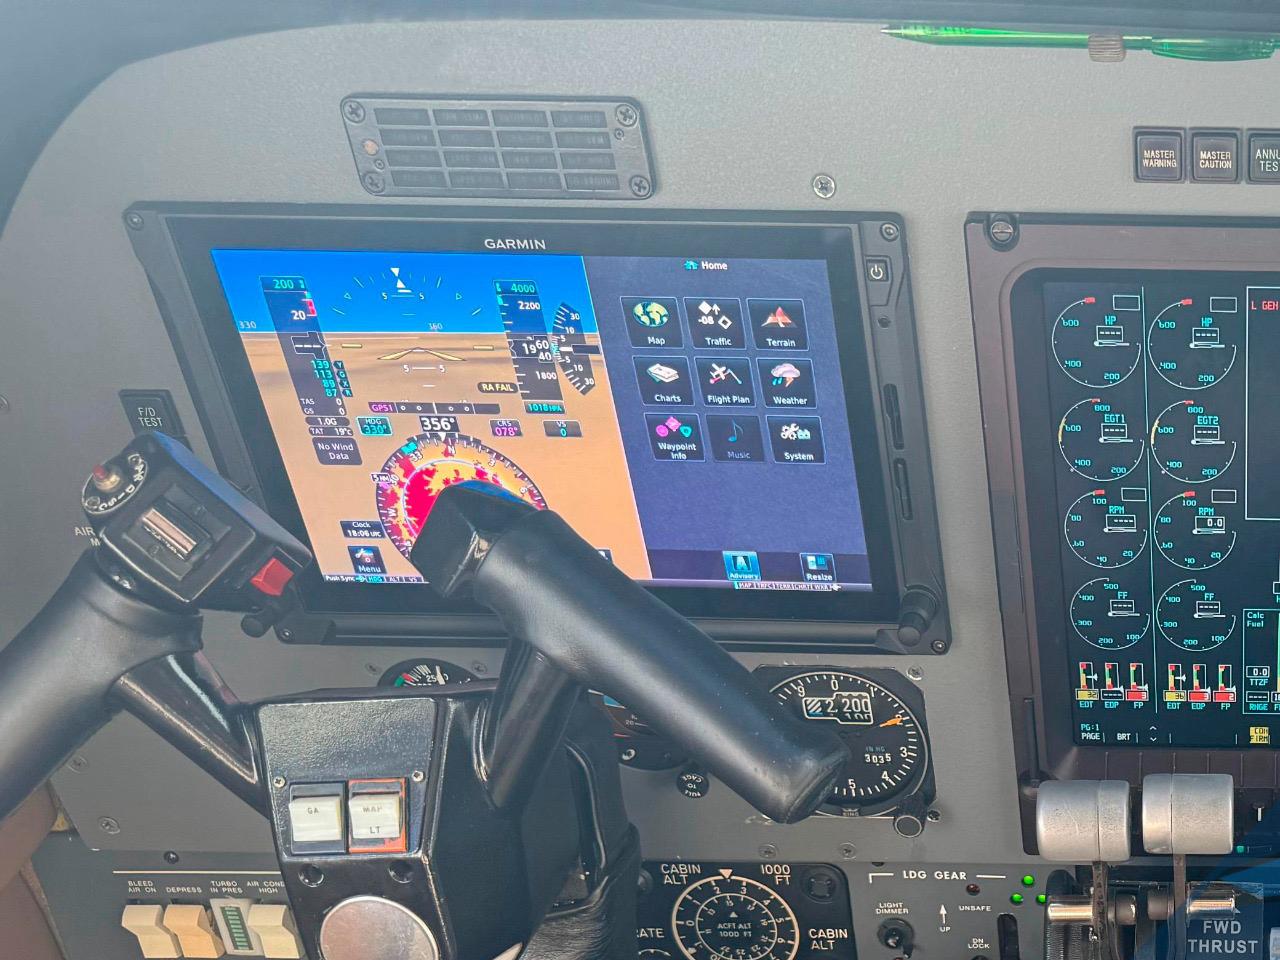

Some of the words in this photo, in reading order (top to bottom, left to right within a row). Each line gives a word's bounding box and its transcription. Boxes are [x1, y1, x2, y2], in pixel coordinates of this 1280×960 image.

[1144, 151, 1175, 159] MASTER
[1201, 151, 1230, 160] MASTER
[1142, 160, 1177, 168] WARNING
[1200, 160, 1231, 169] CAUTION
[484, 239, 546, 251] GARMIN
[702, 261, 727, 270] Home
[510, 283, 535, 293] 4000
[518, 301, 541, 310] 2200
[1261, 301, 1279, 311] GEN
[648, 336, 665, 346] Map
[706, 337, 732, 346] Traffic
[766, 338, 795, 347] Terrain
[481, 383, 492, 391] RA
[496, 383, 514, 392] FAIL
[654, 394, 681, 403] Charts
[708, 395, 730, 405] Flight
[733, 395, 750, 404] Plan
[773, 396, 807, 405] Weather
[138, 407, 156, 417] F/D
[138, 417, 163, 427] TEST
[658, 442, 696, 452] Waypoint
[671, 451, 686, 459] Info
[784, 452, 814, 461] System
[358, 565, 381, 573] Menu
[661, 864, 700, 874] CABIN
[761, 865, 791, 875] 1000
[664, 875, 688, 884] ALT
[903, 871, 927, 879] LDG
[934, 871, 967, 880] GEAR
[776, 876, 791, 885] FT
[1203, 921, 1241, 934] FWD
[1188, 940, 1258, 954] THRUST
